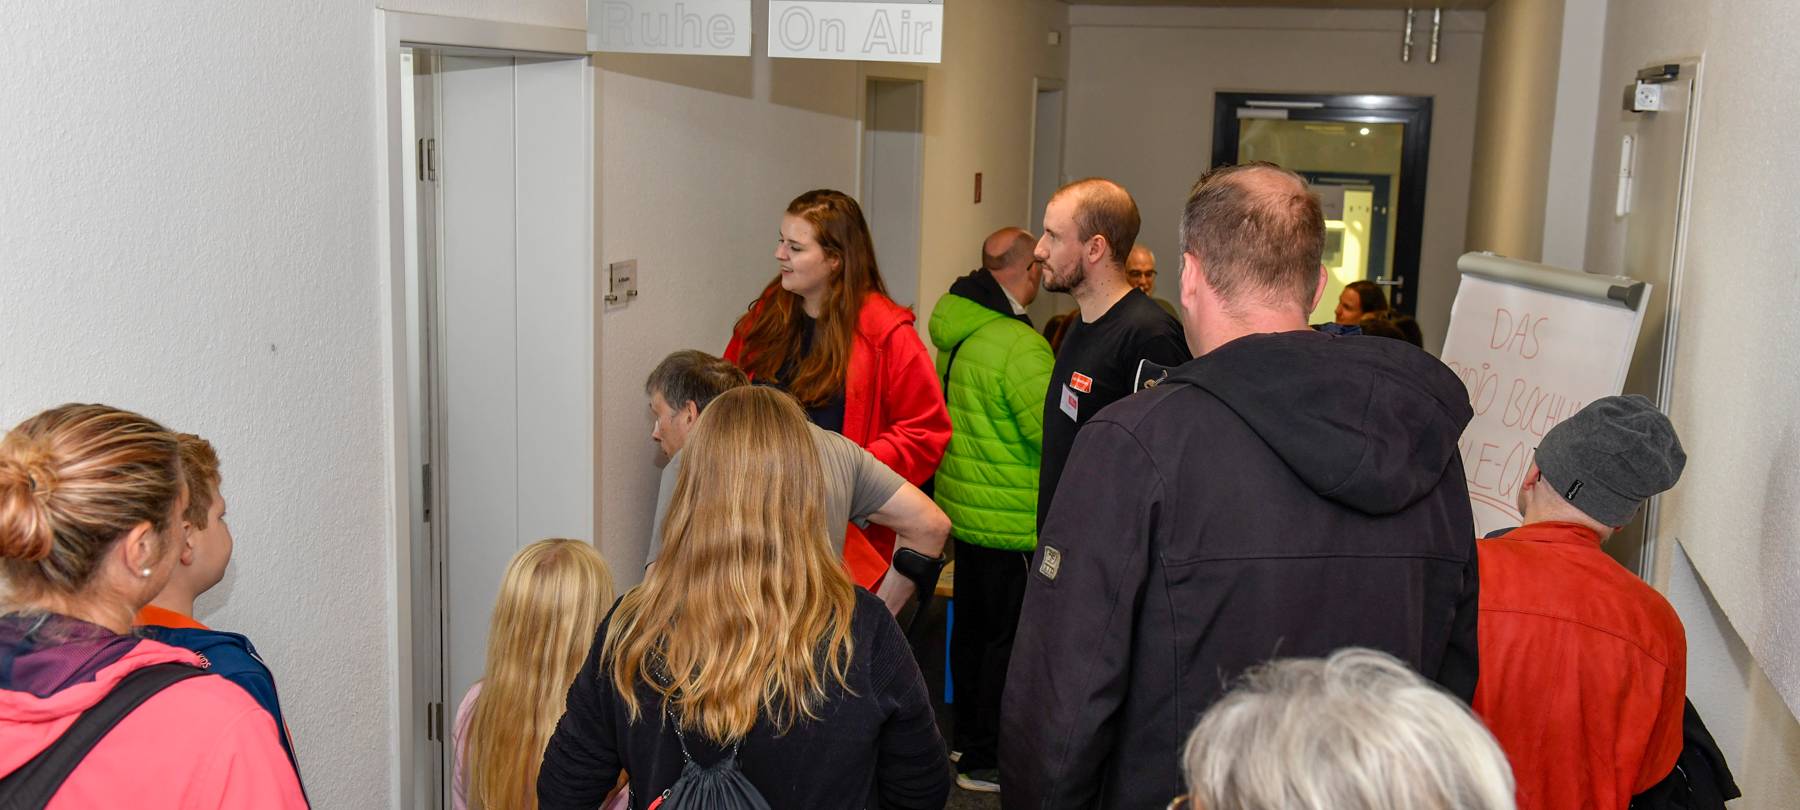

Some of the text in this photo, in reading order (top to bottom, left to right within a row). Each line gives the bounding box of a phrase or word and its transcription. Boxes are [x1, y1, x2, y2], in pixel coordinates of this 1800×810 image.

[600, 1, 736, 49] Ruhe
[779, 6, 933, 55] On Air
[1490, 307, 1549, 359] DAS
